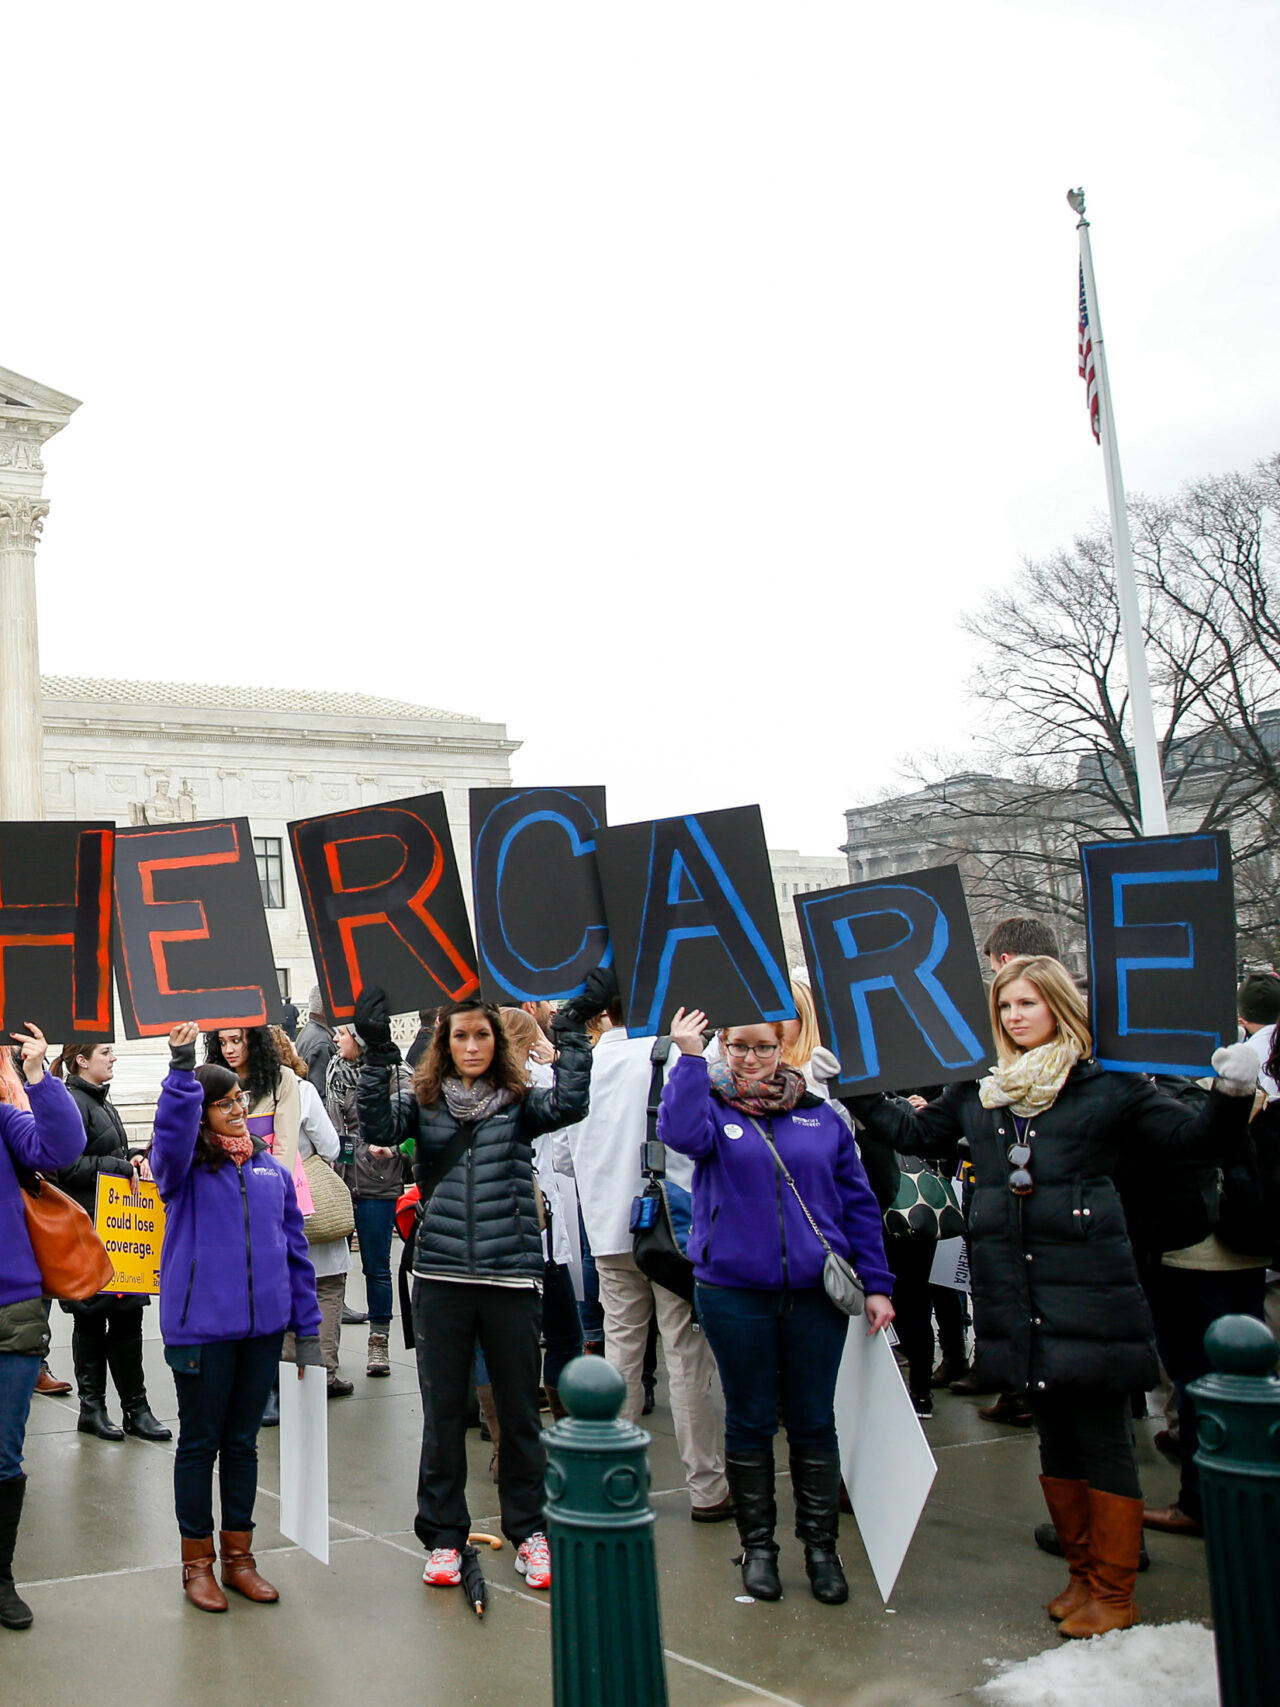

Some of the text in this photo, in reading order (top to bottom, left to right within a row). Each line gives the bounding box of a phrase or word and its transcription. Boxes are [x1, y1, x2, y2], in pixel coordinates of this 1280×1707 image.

[108, 1188, 154, 1209] 8+ million
[106, 1212, 154, 1232] could lose
[105, 1240, 155, 1259] coverage.
